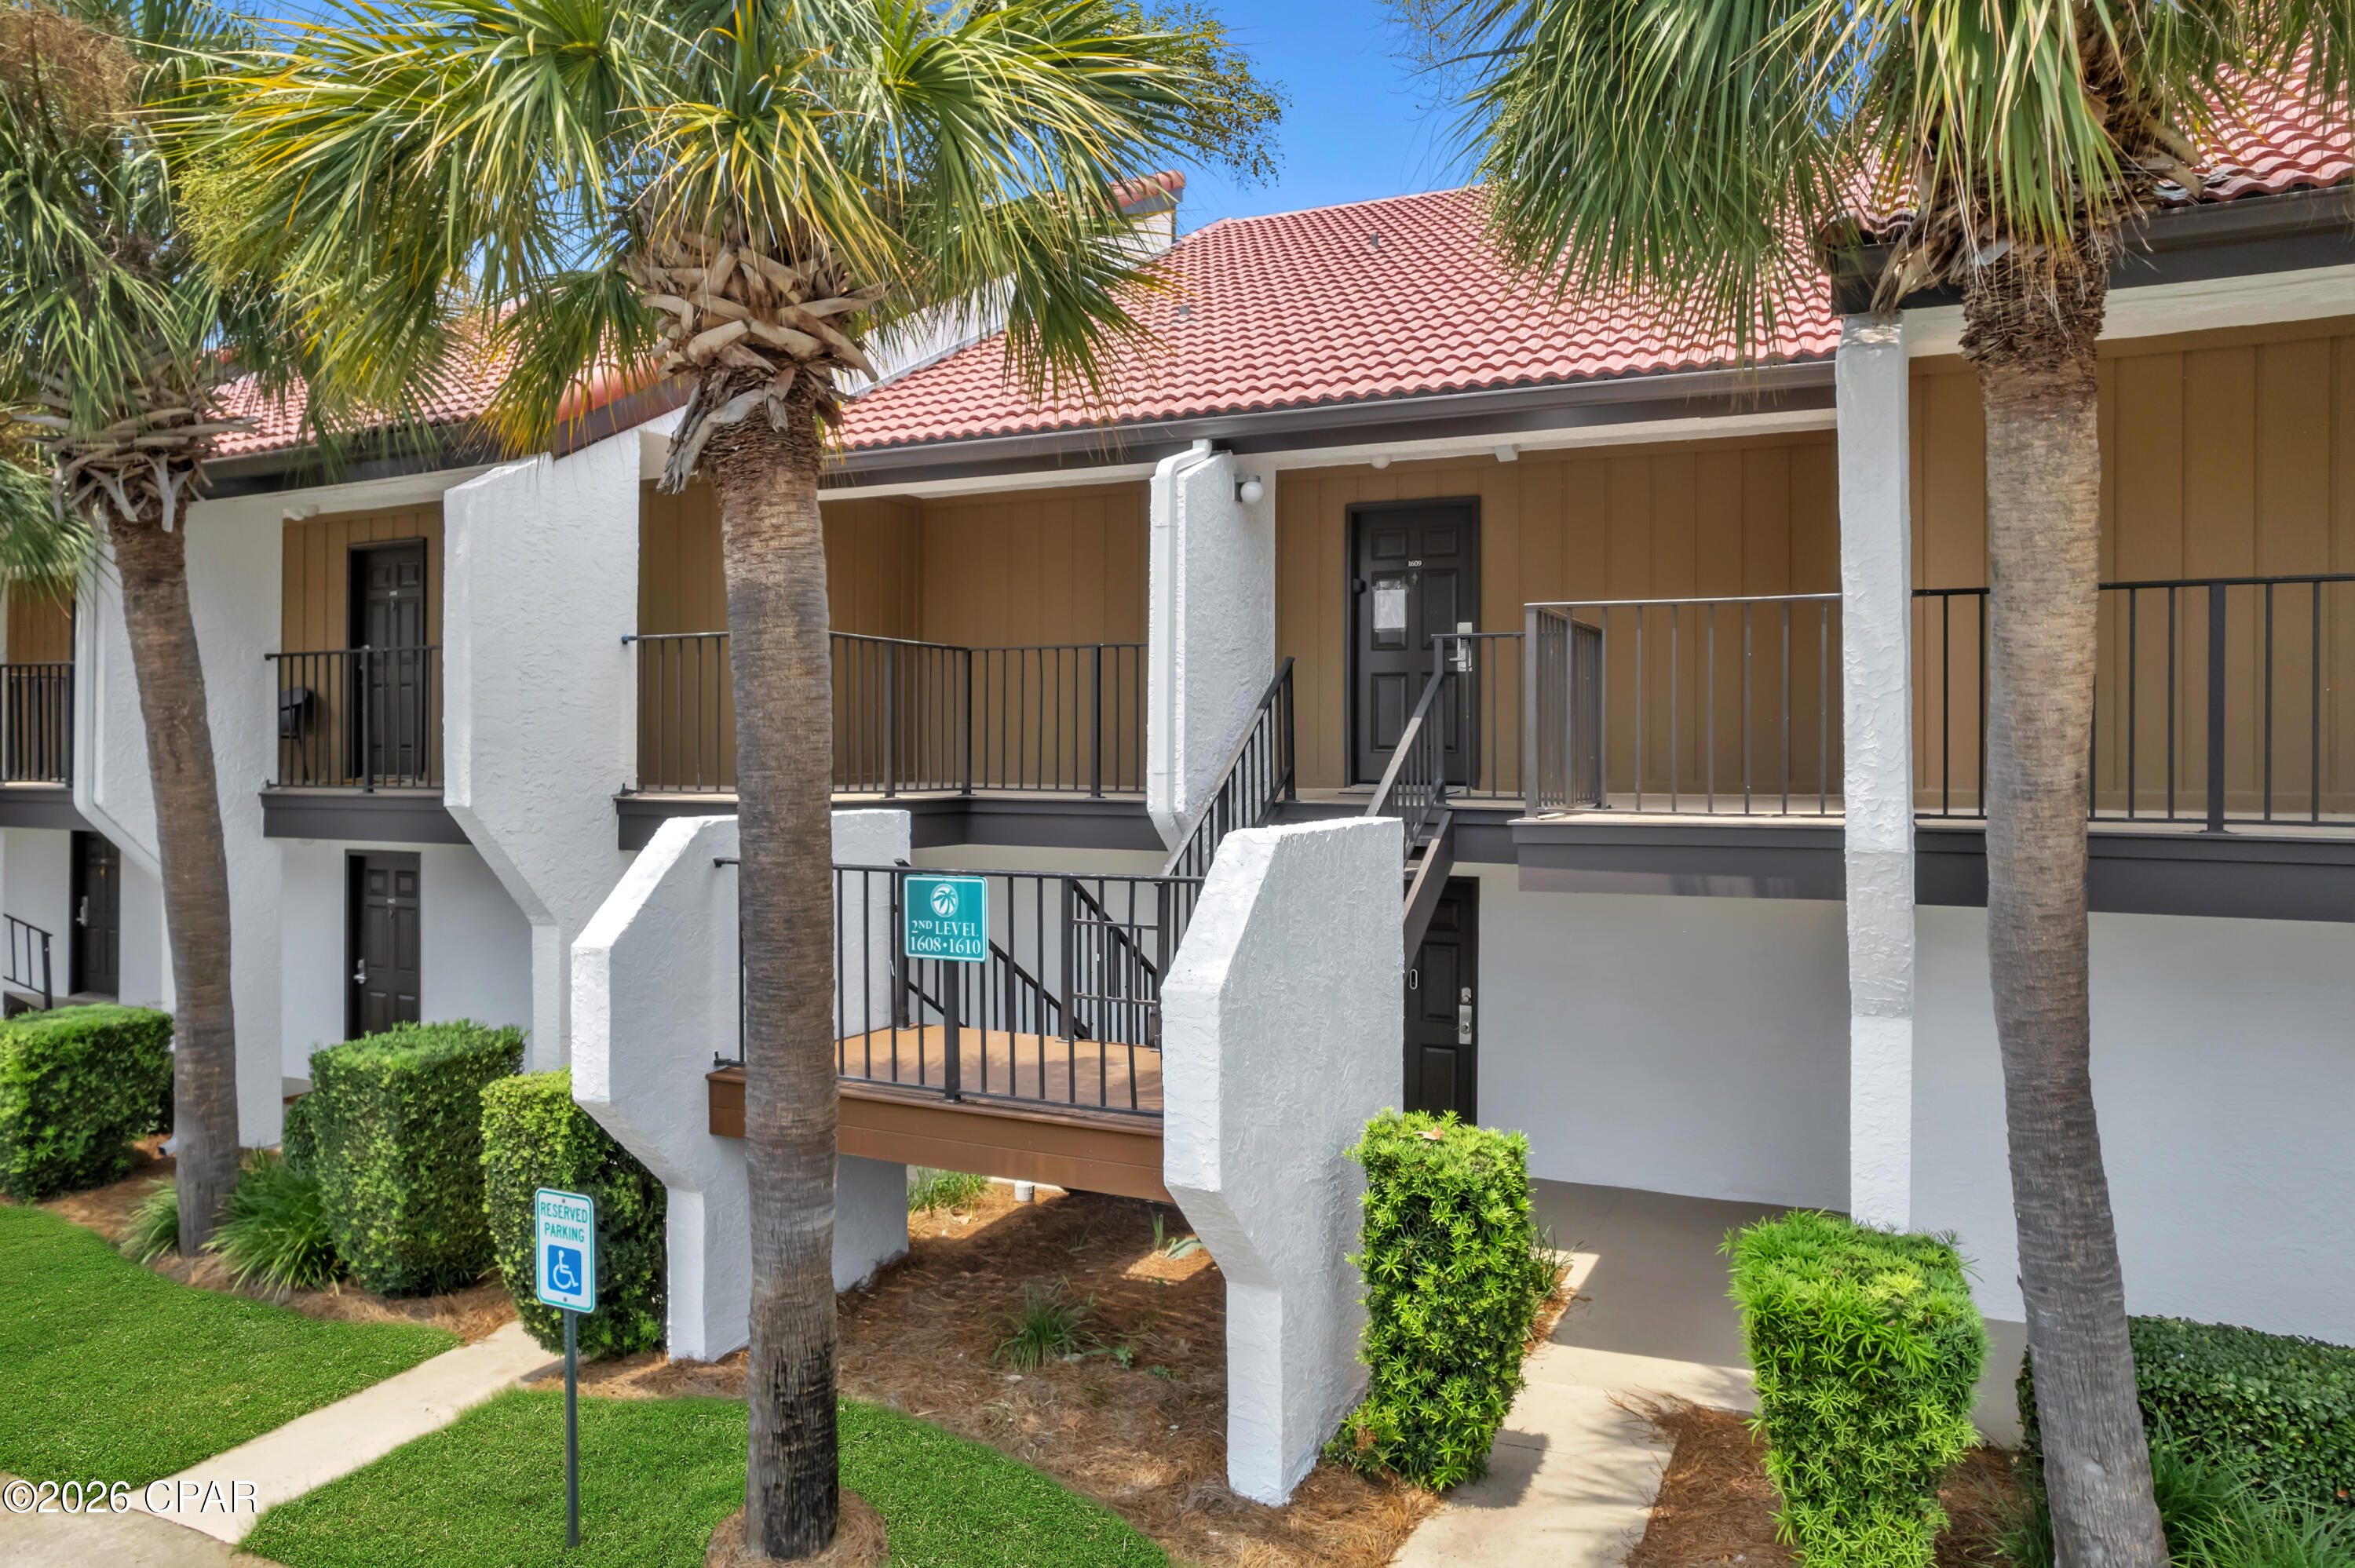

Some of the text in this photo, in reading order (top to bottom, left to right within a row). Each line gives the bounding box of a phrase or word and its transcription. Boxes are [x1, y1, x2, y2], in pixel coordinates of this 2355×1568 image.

[911, 920, 979, 937] 2ND LEVEL
[540, 1202, 588, 1223] RESERVED
[544, 1222, 585, 1242] PARKING
